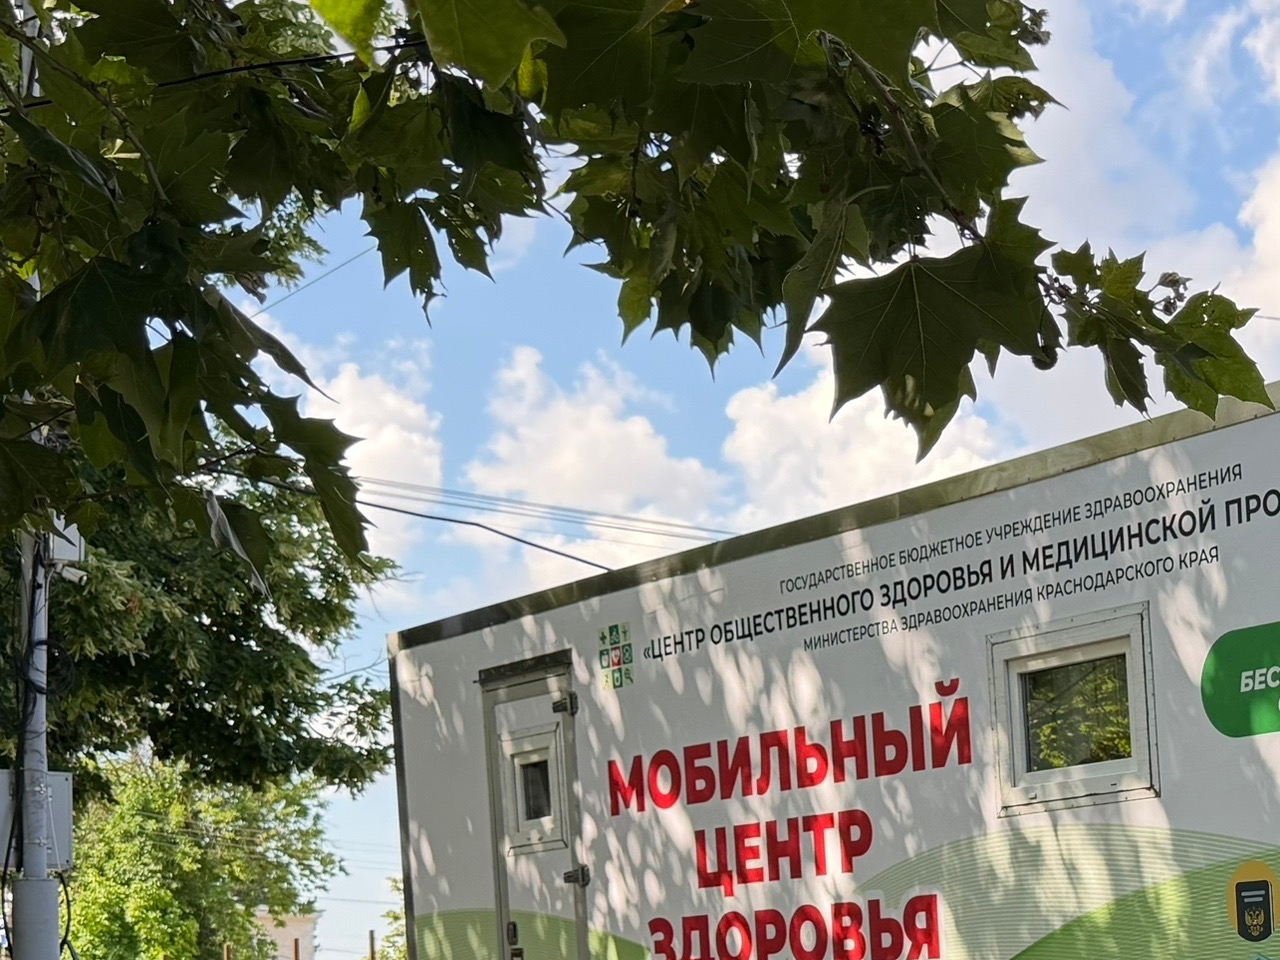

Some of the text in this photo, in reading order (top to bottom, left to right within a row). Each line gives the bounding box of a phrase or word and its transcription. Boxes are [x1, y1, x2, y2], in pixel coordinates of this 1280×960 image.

[643, 624, 705, 661] «ЦЕНТР
[710, 587, 875, 645] ОБЩЕСТВЕННОГО
[879, 558, 993, 608] ЗДОРОВЬЯ
[1000, 553, 1015, 580] И
[1022, 498, 1216, 576] МЕДИЦИНСКОЙ
[780, 463, 1243, 595] ГОСУДАРСТВЕННОЕ БЮДЖЕТНОЕ УЧРЕЖДЕНИЕ ЗДРАВООХРАНЕНИЯ
[803, 545, 1219, 652] МИНИСТЕРСТВА ЗДРАВООХРАНЕНИЯ КРАСНОДАРСКОГО КРАЯ
[607, 678, 973, 817] МОБИЛЬНЫЙ
[694, 809, 873, 897] ЦЕНТР
